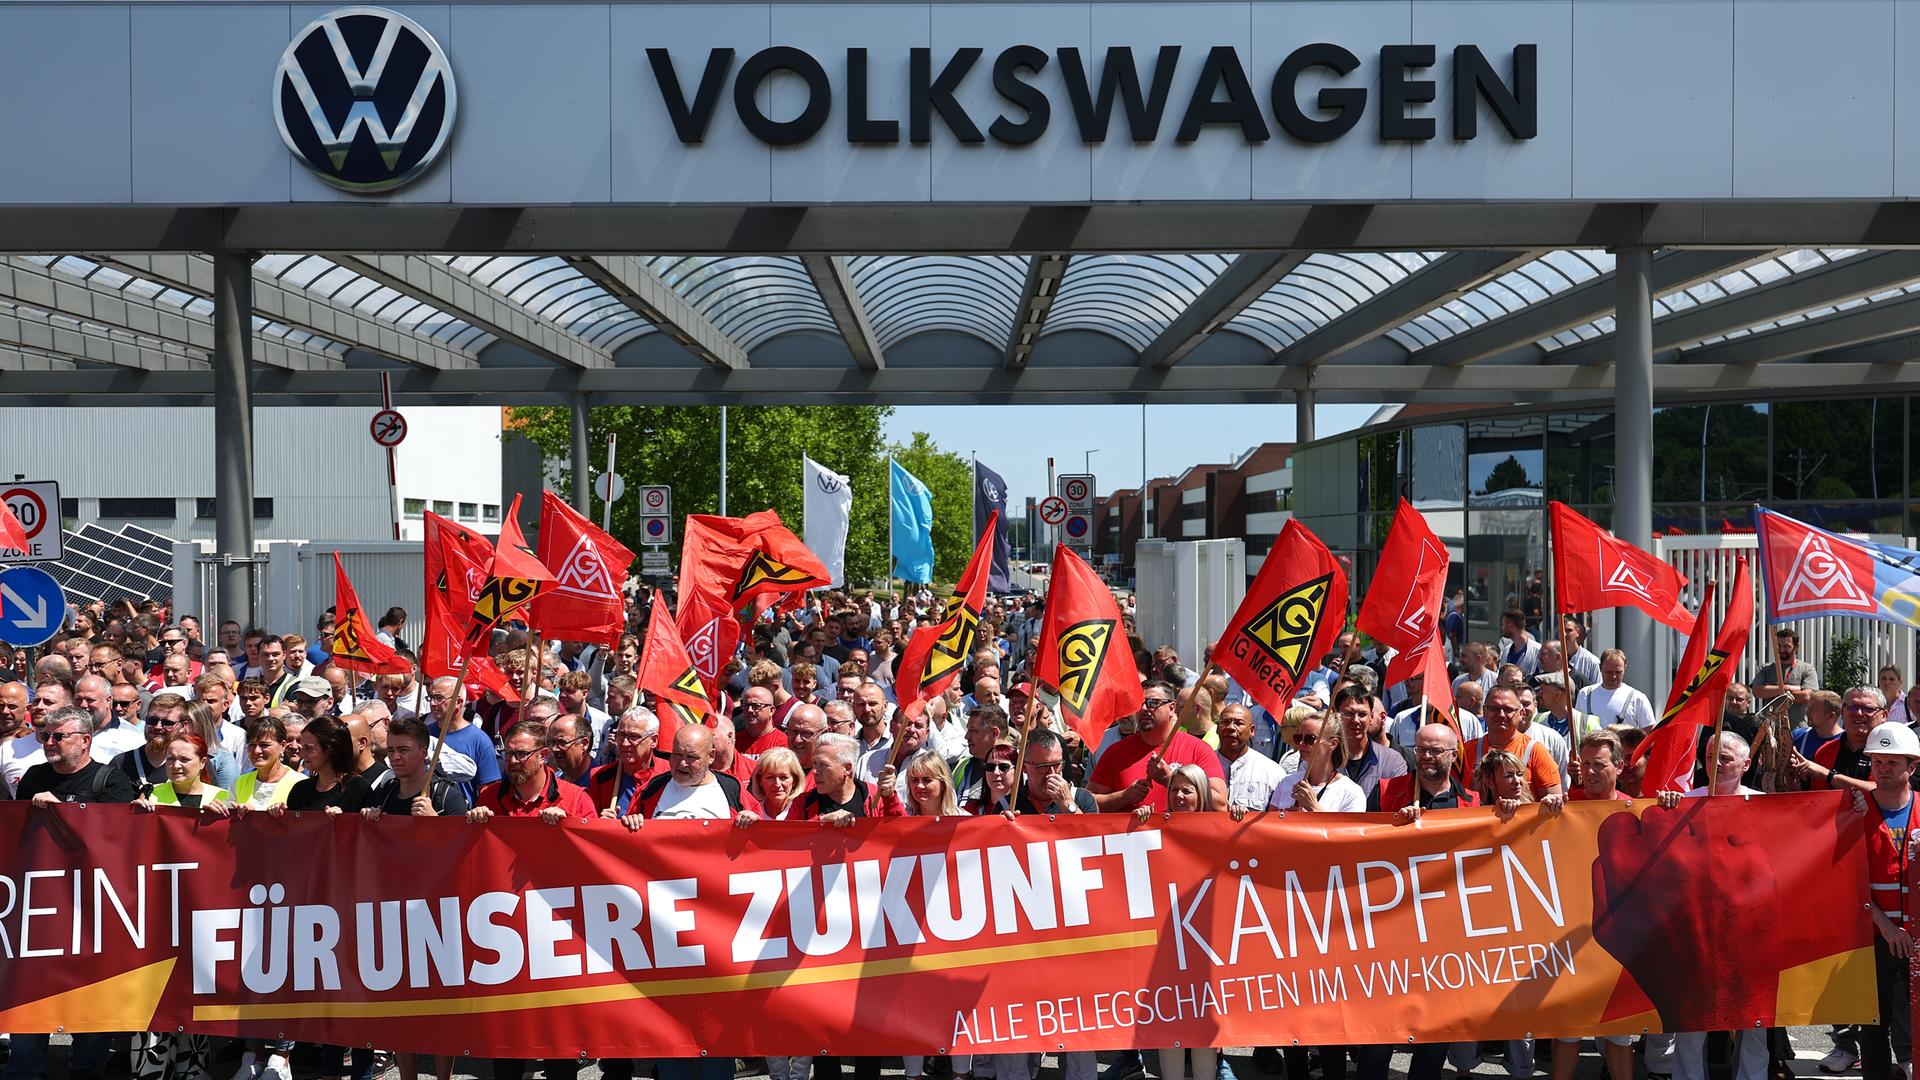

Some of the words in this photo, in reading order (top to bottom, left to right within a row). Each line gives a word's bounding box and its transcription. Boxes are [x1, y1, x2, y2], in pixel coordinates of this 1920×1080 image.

[645, 42, 1538, 149] VOLKSWAGEN
[1070, 485, 1084, 494] 30
[1228, 633, 1251, 661] IG
[1248, 646, 1294, 705] Metall
[192, 882, 342, 995] FÜR
[355, 877, 706, 992] UNSERE
[729, 829, 1163, 964] ZUKUNFT
[1168, 839, 1566, 971] KÄMPFEN
[951, 1003, 1028, 1048] ALLE
[1036, 971, 1300, 1038] BELEGSCHAFTEN
[1310, 967, 1347, 1004] IM
[1354, 940, 1576, 999] VW-KONZERN
